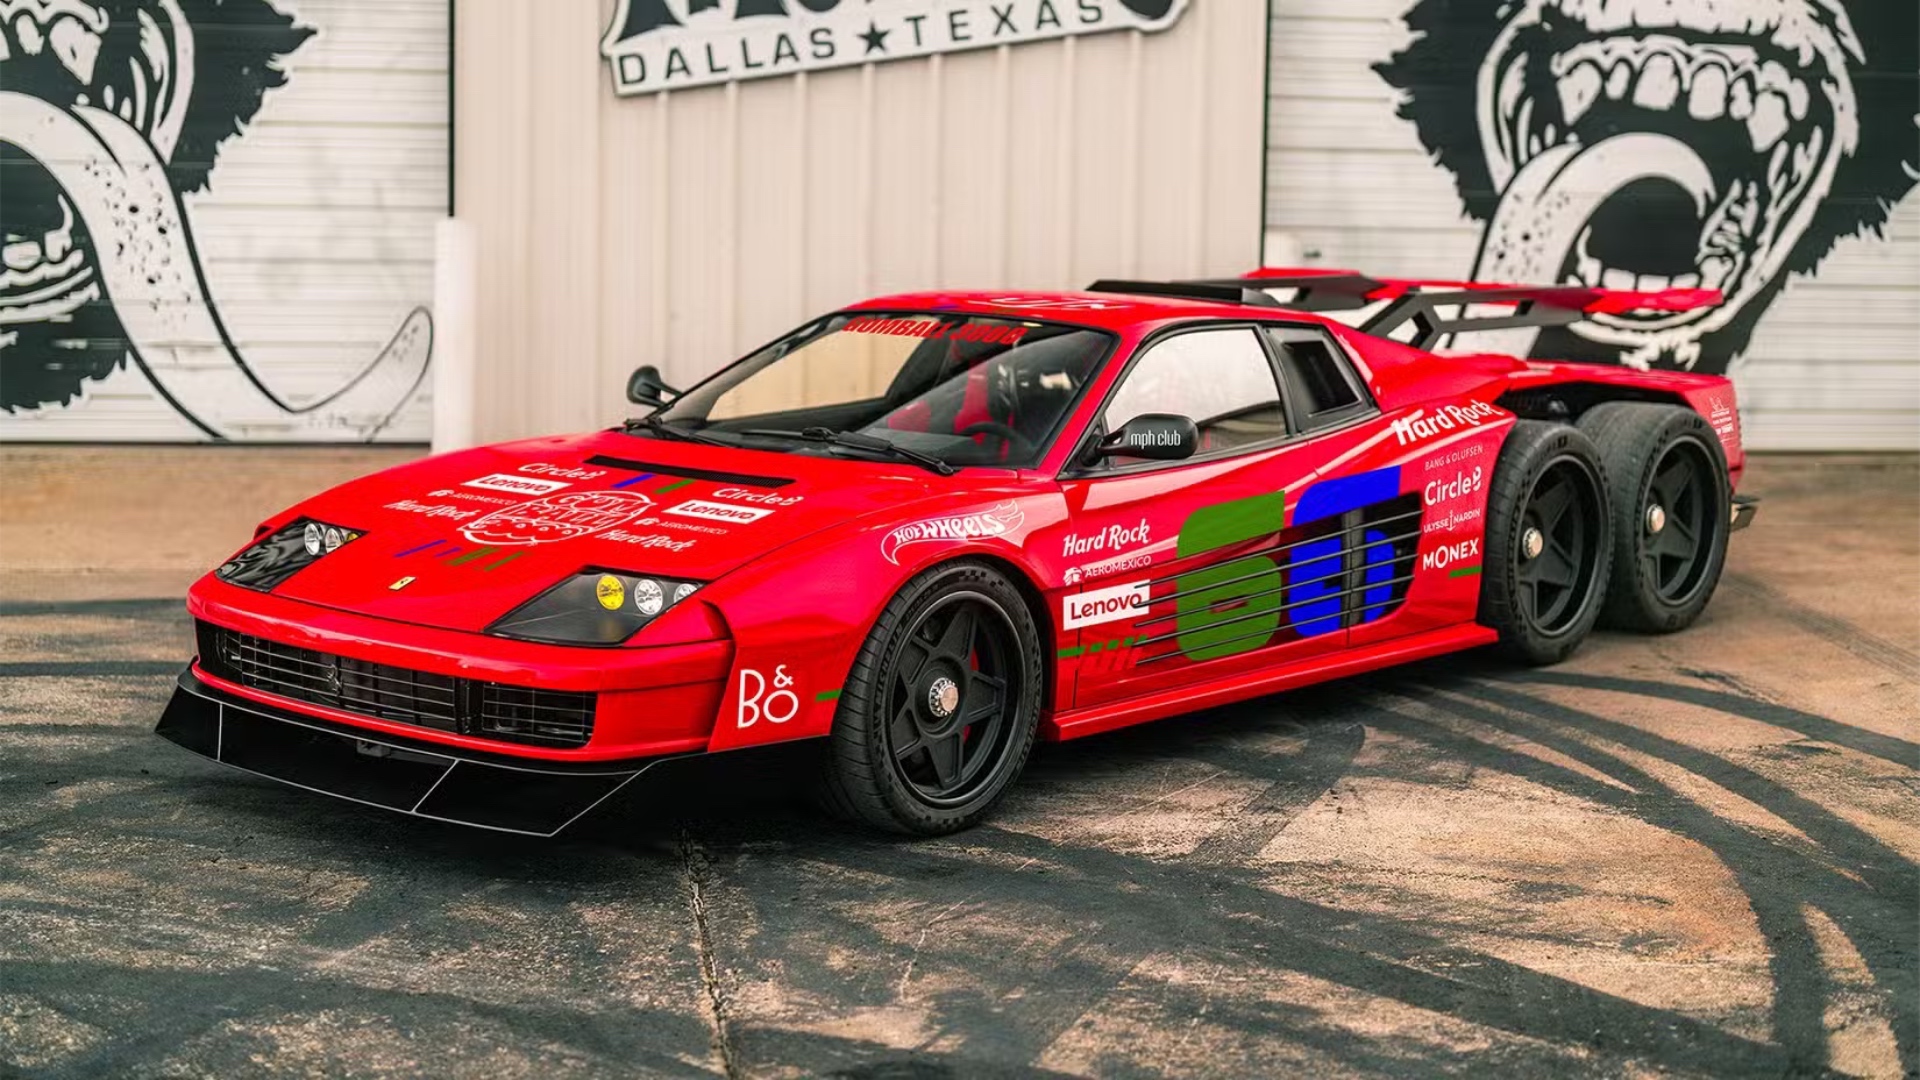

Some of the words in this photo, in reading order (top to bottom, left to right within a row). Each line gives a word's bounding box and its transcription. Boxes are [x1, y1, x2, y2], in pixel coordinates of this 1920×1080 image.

[618, 28, 836, 85] DALLAS
[904, 0, 1104, 46] TEXAS
[842, 316, 952, 339] GUMBALL
[1390, 408, 1456, 446] Hard
[1444, 399, 1505, 426] Rock
[1130, 430, 1156, 449] mph
[1157, 430, 1181, 447] club
[1425, 457, 1445, 471] BANG
[1451, 444, 1483, 461] OLUFSEN
[477, 476, 552, 492] Lenovo
[678, 503, 757, 519] Lenovo
[1423, 518, 1450, 533] ULYSSE
[1453, 508, 1481, 524] NARDIN
[893, 523, 921, 547] HOT
[1062, 526, 1107, 557] Hard
[1107, 517, 1151, 551] Rock
[1422, 537, 1480, 570] MONEX
[1084, 555, 1152, 578] AEROMEXICO
[1070, 593, 1142, 620] Lenovo
